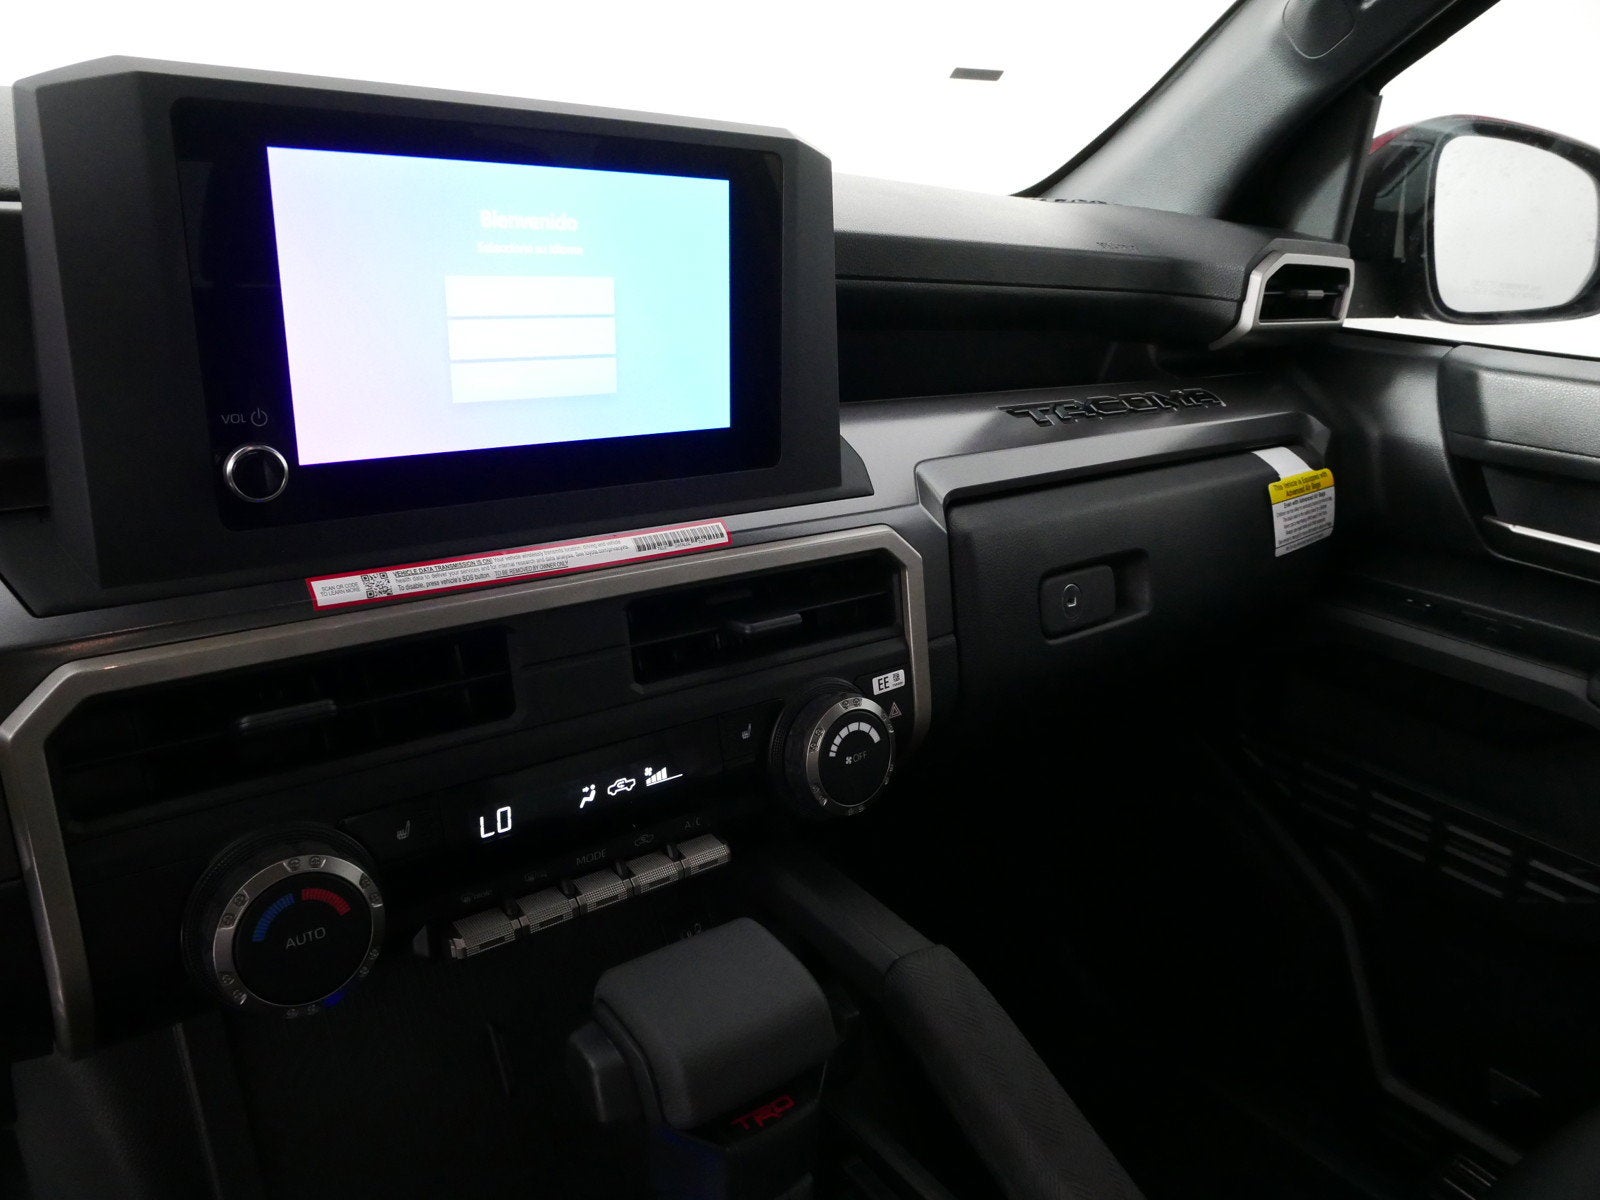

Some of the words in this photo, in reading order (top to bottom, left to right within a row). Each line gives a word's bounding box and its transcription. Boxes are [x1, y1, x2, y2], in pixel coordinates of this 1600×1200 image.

[996, 388, 1226, 427] TACOMA
[220, 413, 247, 424] VOL
[393, 569, 419, 578] VEHICLE
[419, 566, 434, 575] DATA
[434, 560, 476, 572] TRANSMISSION
[426, 579, 440, 588] press
[462, 574, 474, 582] SOS
[877, 675, 890, 692] EE
[853, 750, 868, 763] OFF
[575, 848, 608, 867] MODE
[285, 926, 327, 950] AUTO
[730, 1092, 797, 1131] TRD
